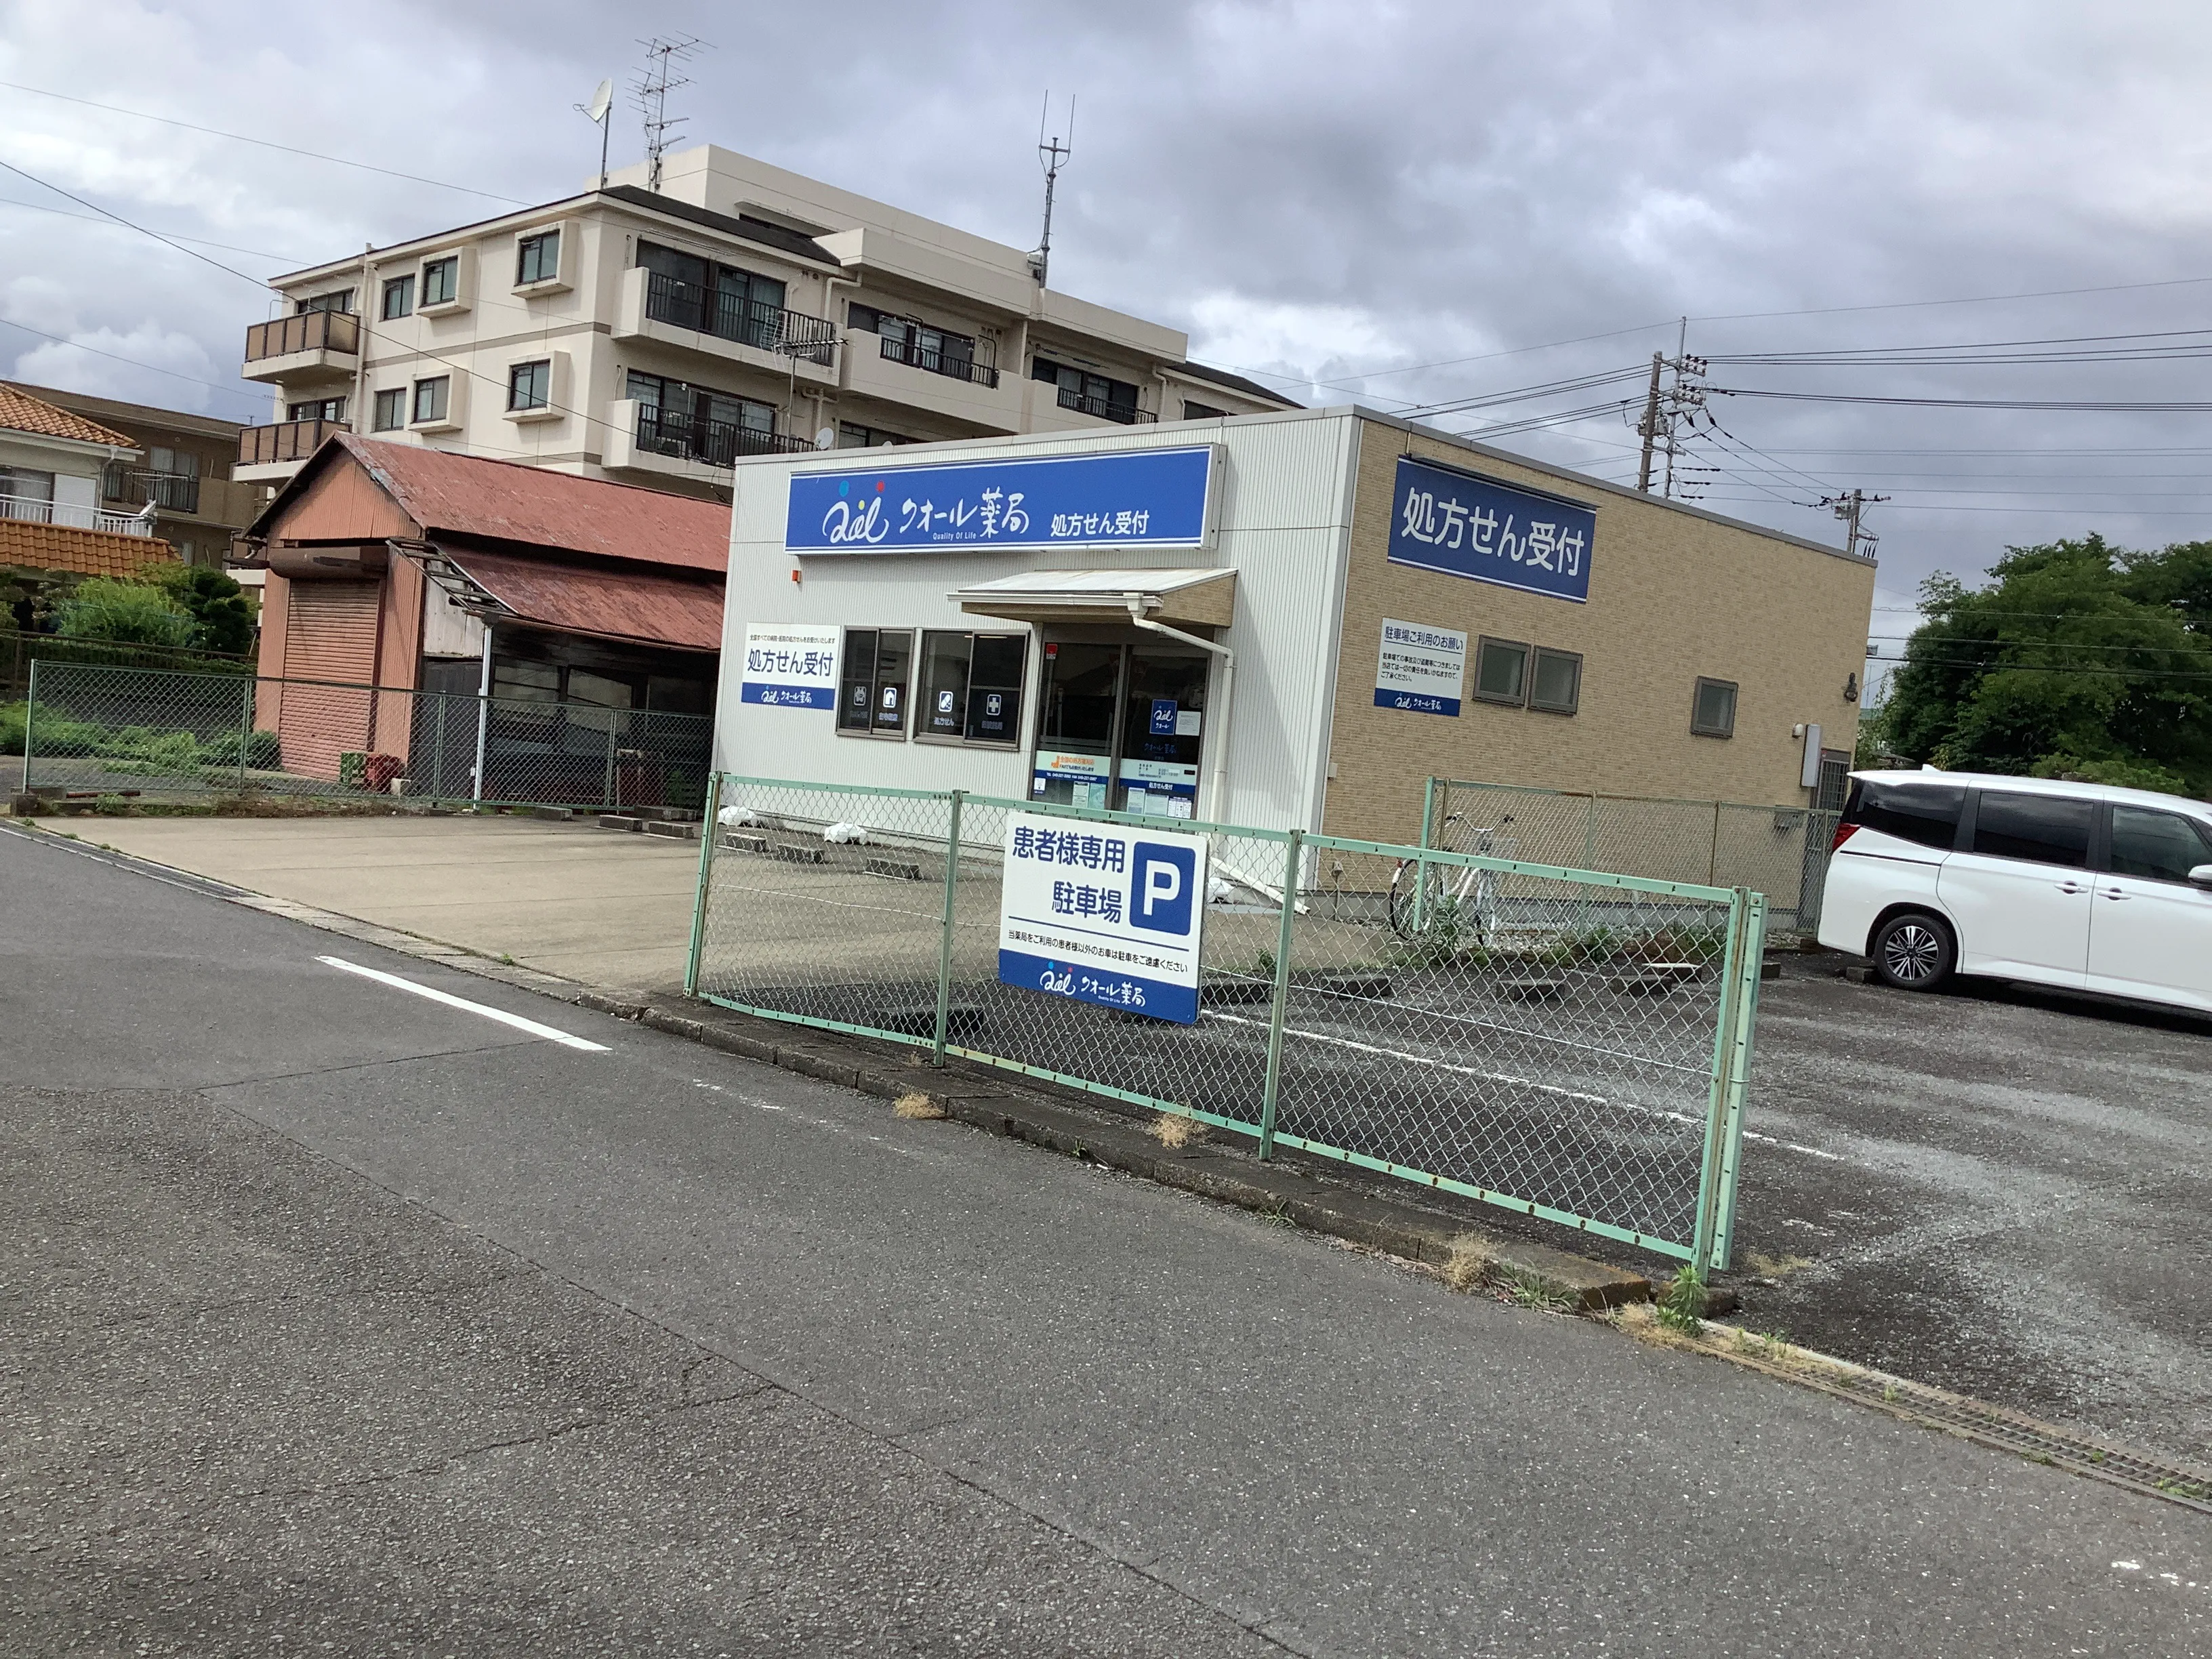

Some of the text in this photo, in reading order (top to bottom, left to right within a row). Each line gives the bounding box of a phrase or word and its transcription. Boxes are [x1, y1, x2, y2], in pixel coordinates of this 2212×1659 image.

[933, 531, 977, 541] Quality Of Life
[1050, 510, 1150, 538] 処方せん受付
[1401, 487, 1584, 577] 処方せん受付
[1385, 626, 1463, 650] 駐車場ご利用のお願い
[747, 648, 834, 677] 処方せん受付
[934, 716, 954, 726] 処方せん
[1149, 782, 1173, 791] 処方せん受付
[1012, 826, 1126, 873] 患者様専用
[1052, 880, 1122, 924] 駐車場
[1143, 859, 1181, 916] P
[1008, 929, 1188, 973] 当薬局をご利用の患者様以外のお車は駐車をご遠慮ください
